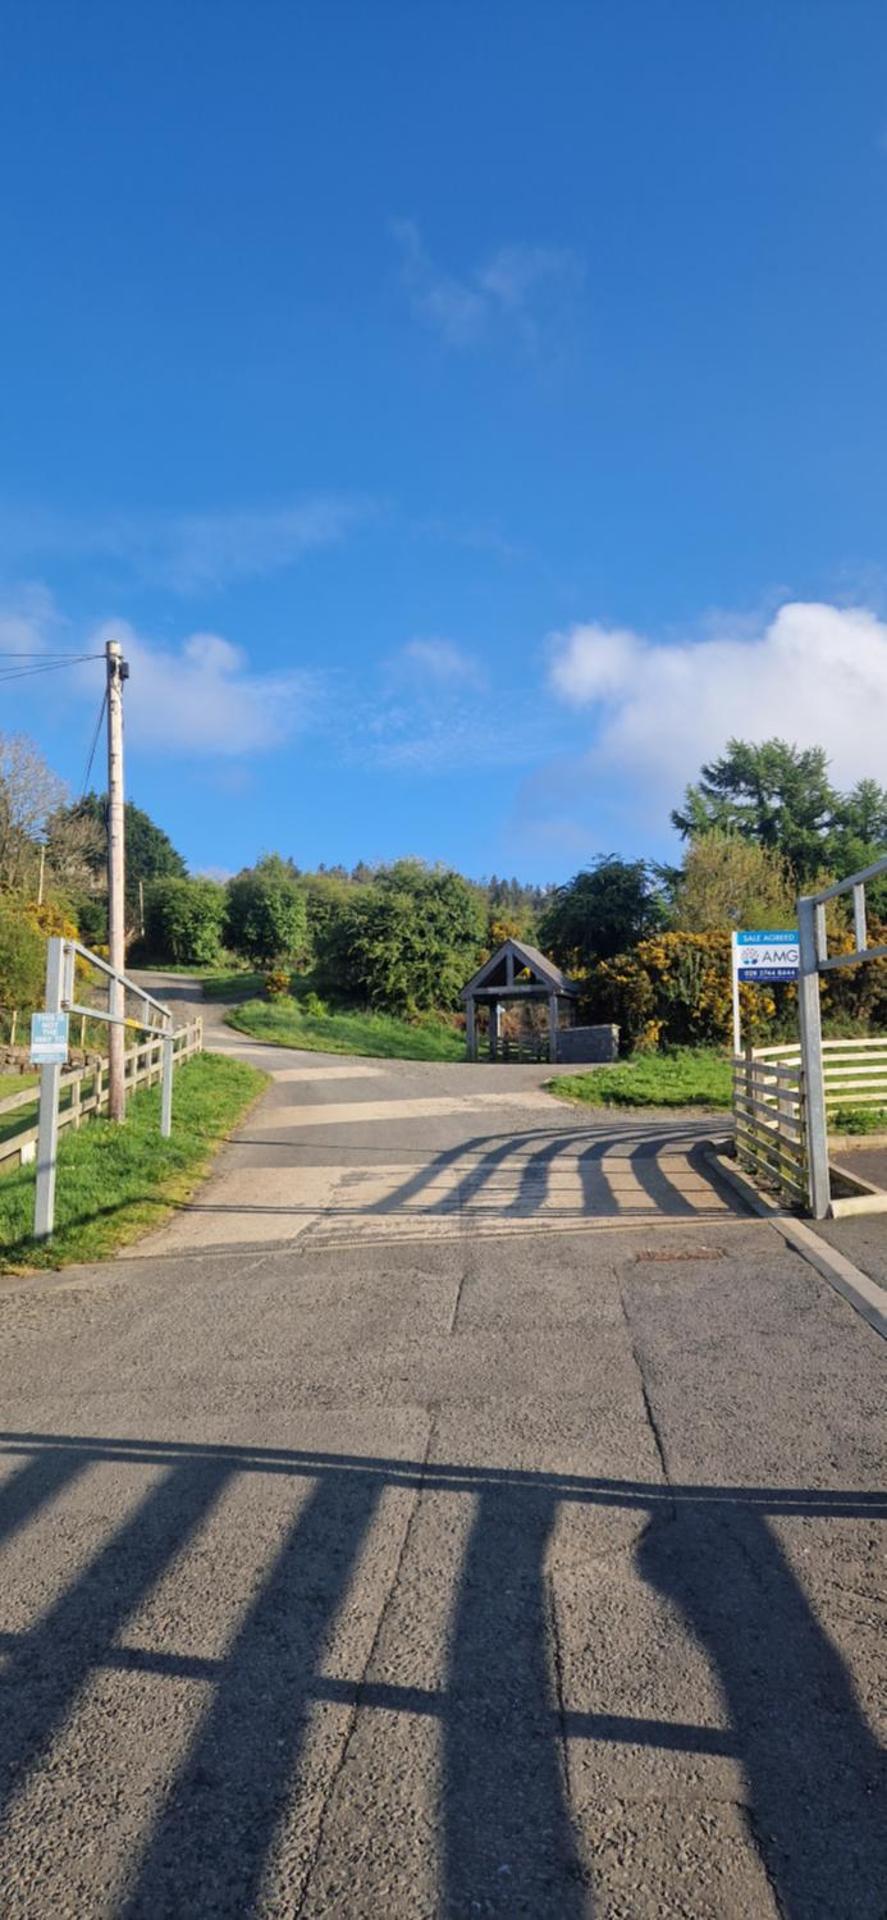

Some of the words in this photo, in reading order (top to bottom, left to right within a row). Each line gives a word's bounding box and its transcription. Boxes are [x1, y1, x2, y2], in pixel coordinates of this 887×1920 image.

[743, 934, 760, 942] SALE
[763, 934, 795, 942] AGREED
[762, 949, 798, 962] AMG
